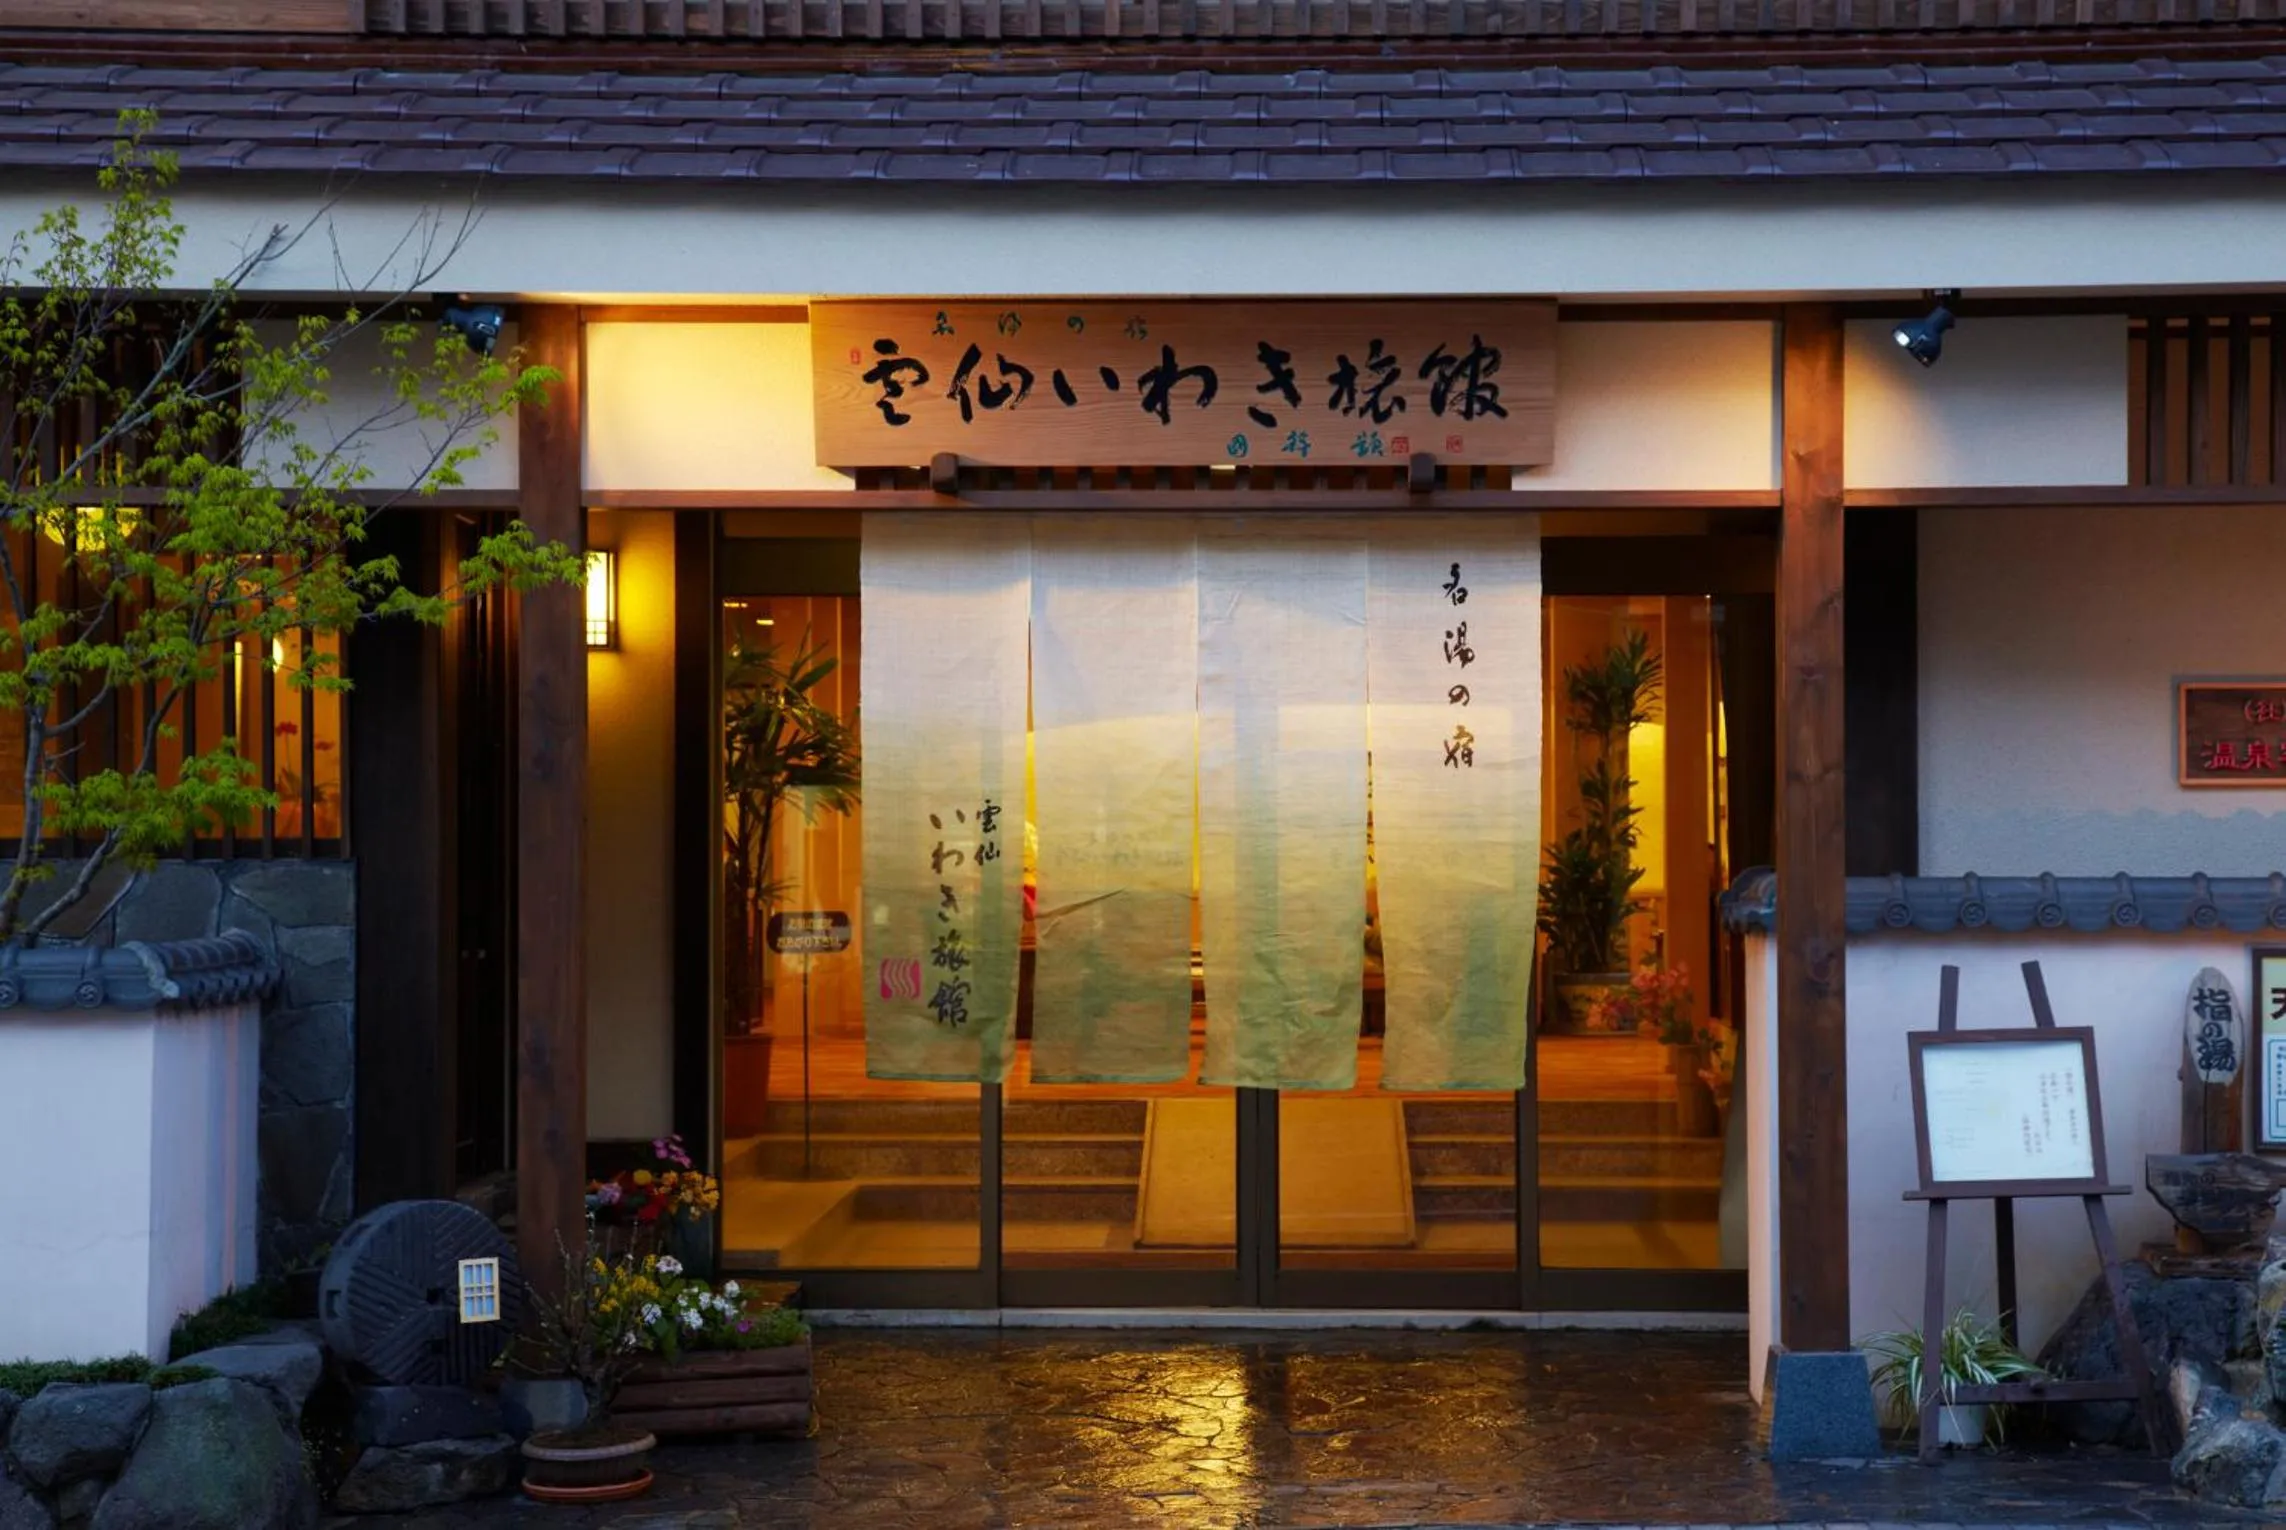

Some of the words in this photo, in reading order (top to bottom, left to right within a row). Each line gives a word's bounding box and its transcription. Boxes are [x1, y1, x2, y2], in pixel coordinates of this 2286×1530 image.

[1442, 562, 1475, 768] 名湯の宿
[2200, 740, 2286, 770] 温泉
[928, 809, 971, 1028] いわき旅館
